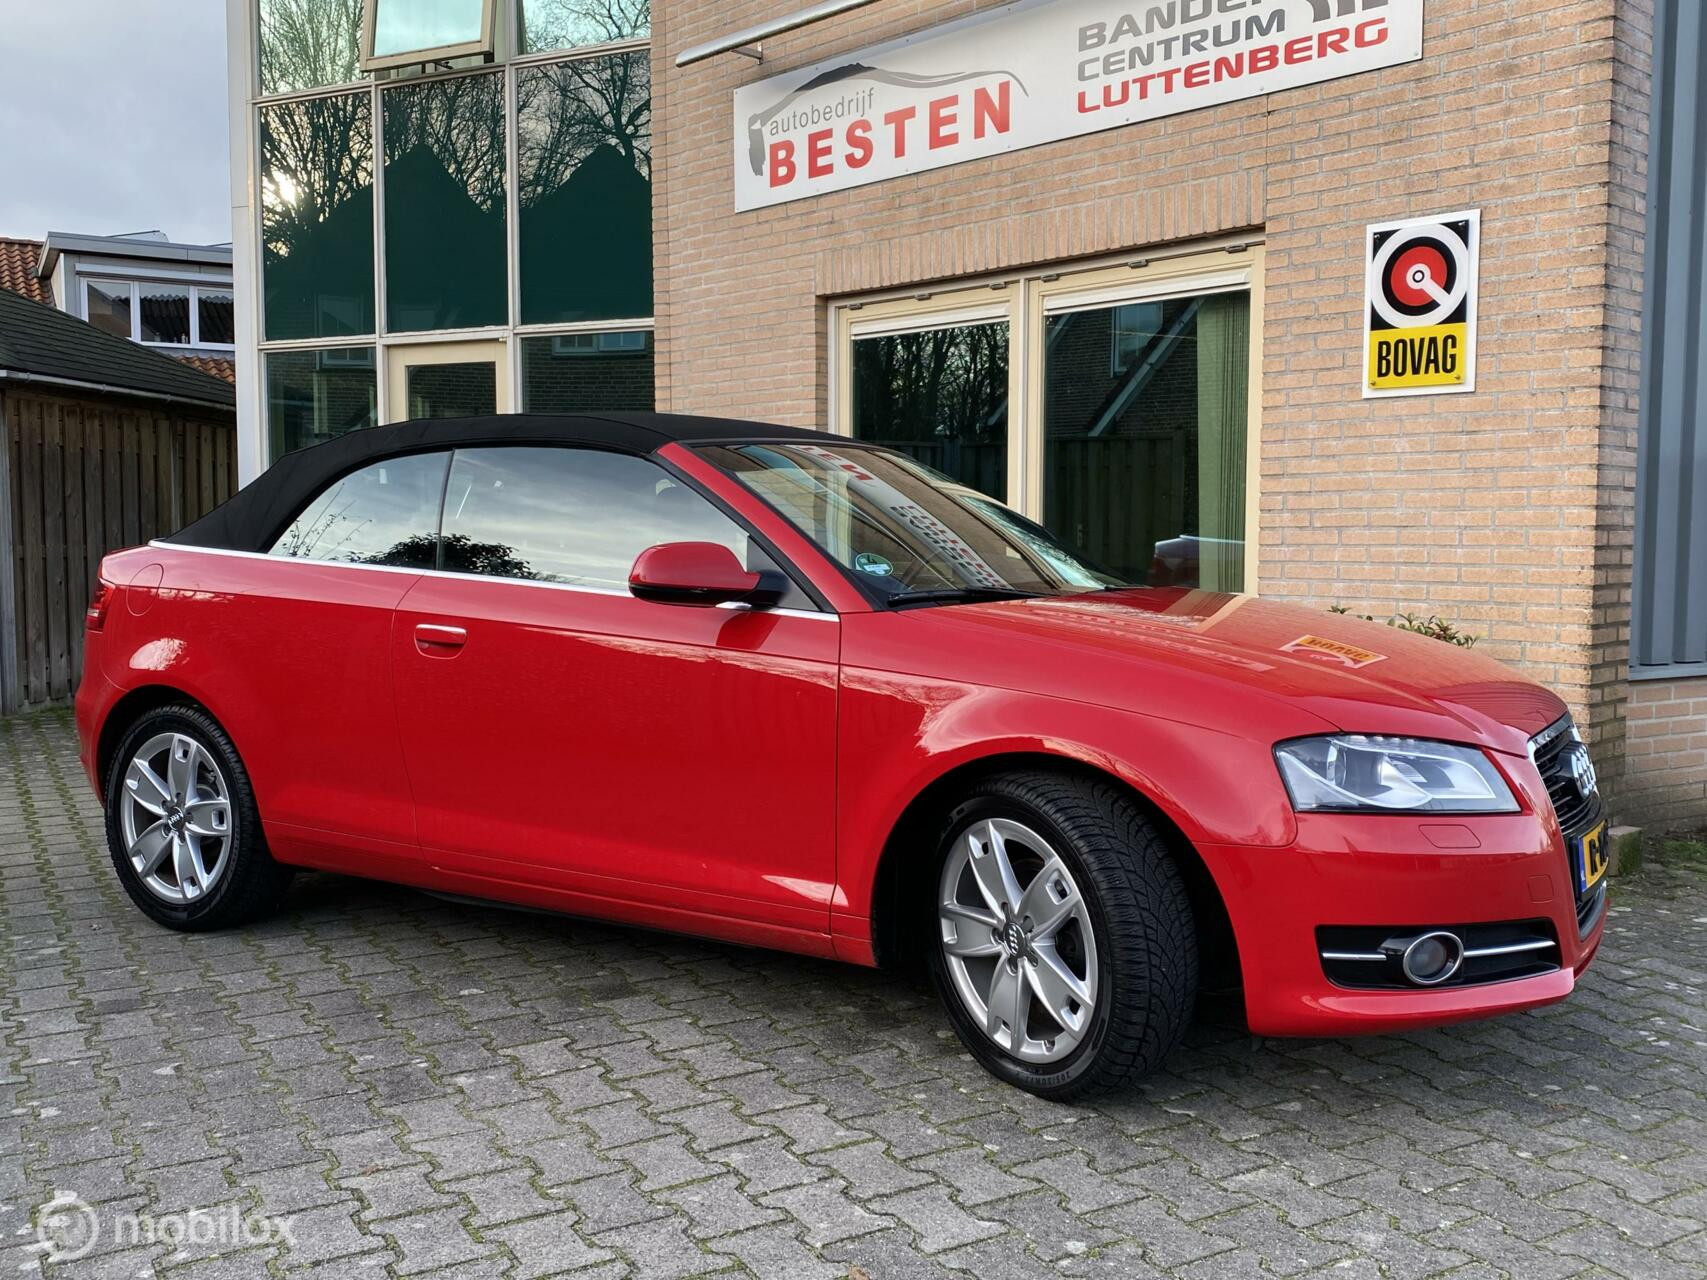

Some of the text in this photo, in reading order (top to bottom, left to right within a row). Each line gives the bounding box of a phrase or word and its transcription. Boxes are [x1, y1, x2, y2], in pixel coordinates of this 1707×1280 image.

[1078, 9, 1285, 81] CENTRUM
[1078, 17, 1389, 113] LUTTENBERG
[769, 87, 875, 136] autobedrijf
[769, 80, 1010, 188] BESTEN
[1377, 334, 1457, 378] BOVAG
